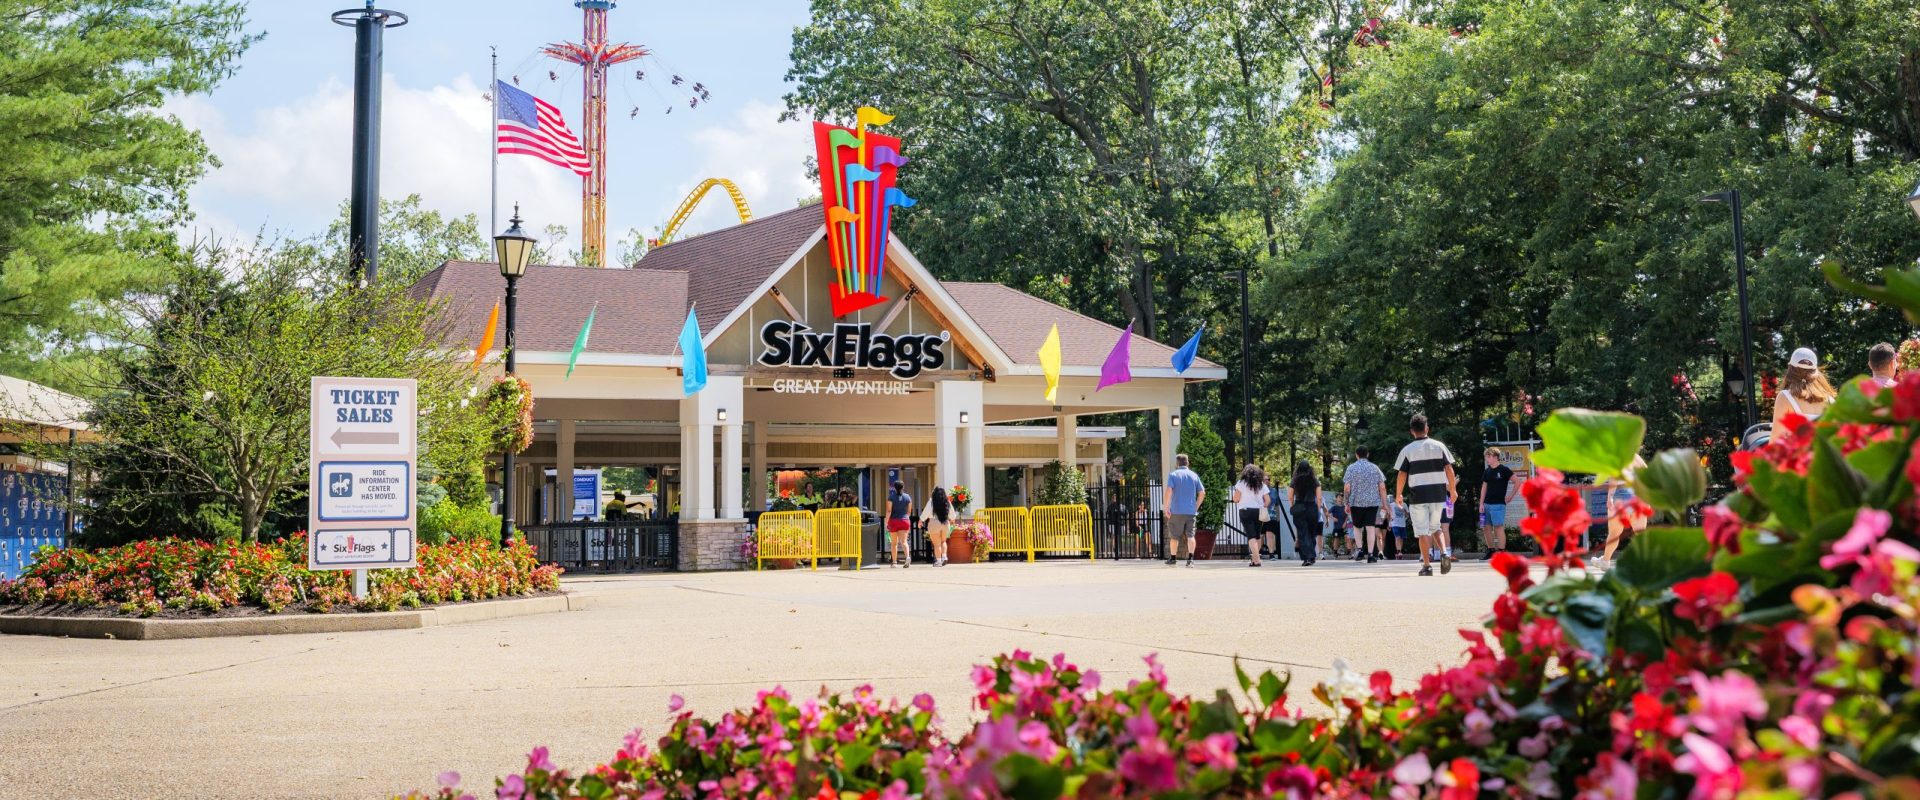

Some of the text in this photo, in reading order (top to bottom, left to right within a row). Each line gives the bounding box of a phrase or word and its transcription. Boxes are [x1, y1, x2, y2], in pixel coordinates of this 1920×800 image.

[773, 378, 910, 395] GREAT ADVENTURE
[331, 389, 399, 405] TICKET
[337, 407, 393, 423] SALES
[333, 543, 376, 554] Six Flags
